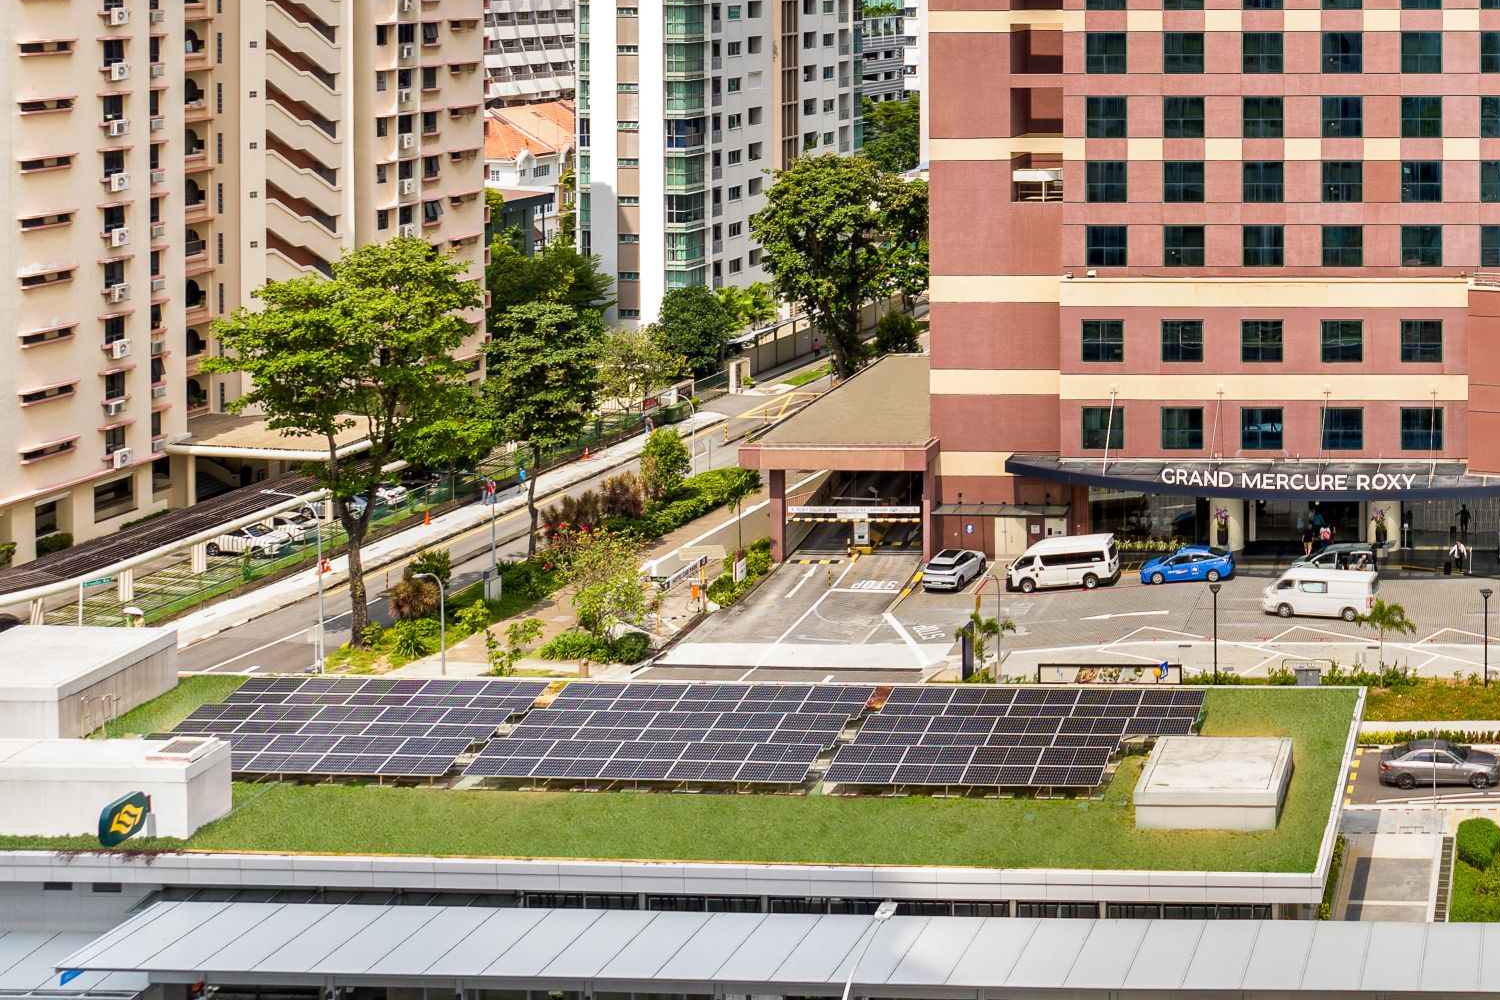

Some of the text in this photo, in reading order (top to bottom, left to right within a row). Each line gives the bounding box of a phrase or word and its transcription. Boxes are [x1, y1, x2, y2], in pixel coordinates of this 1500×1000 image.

[1161, 468, 1416, 491] GRAND MERCURE ROXY
[850, 580, 899, 590] STOP
